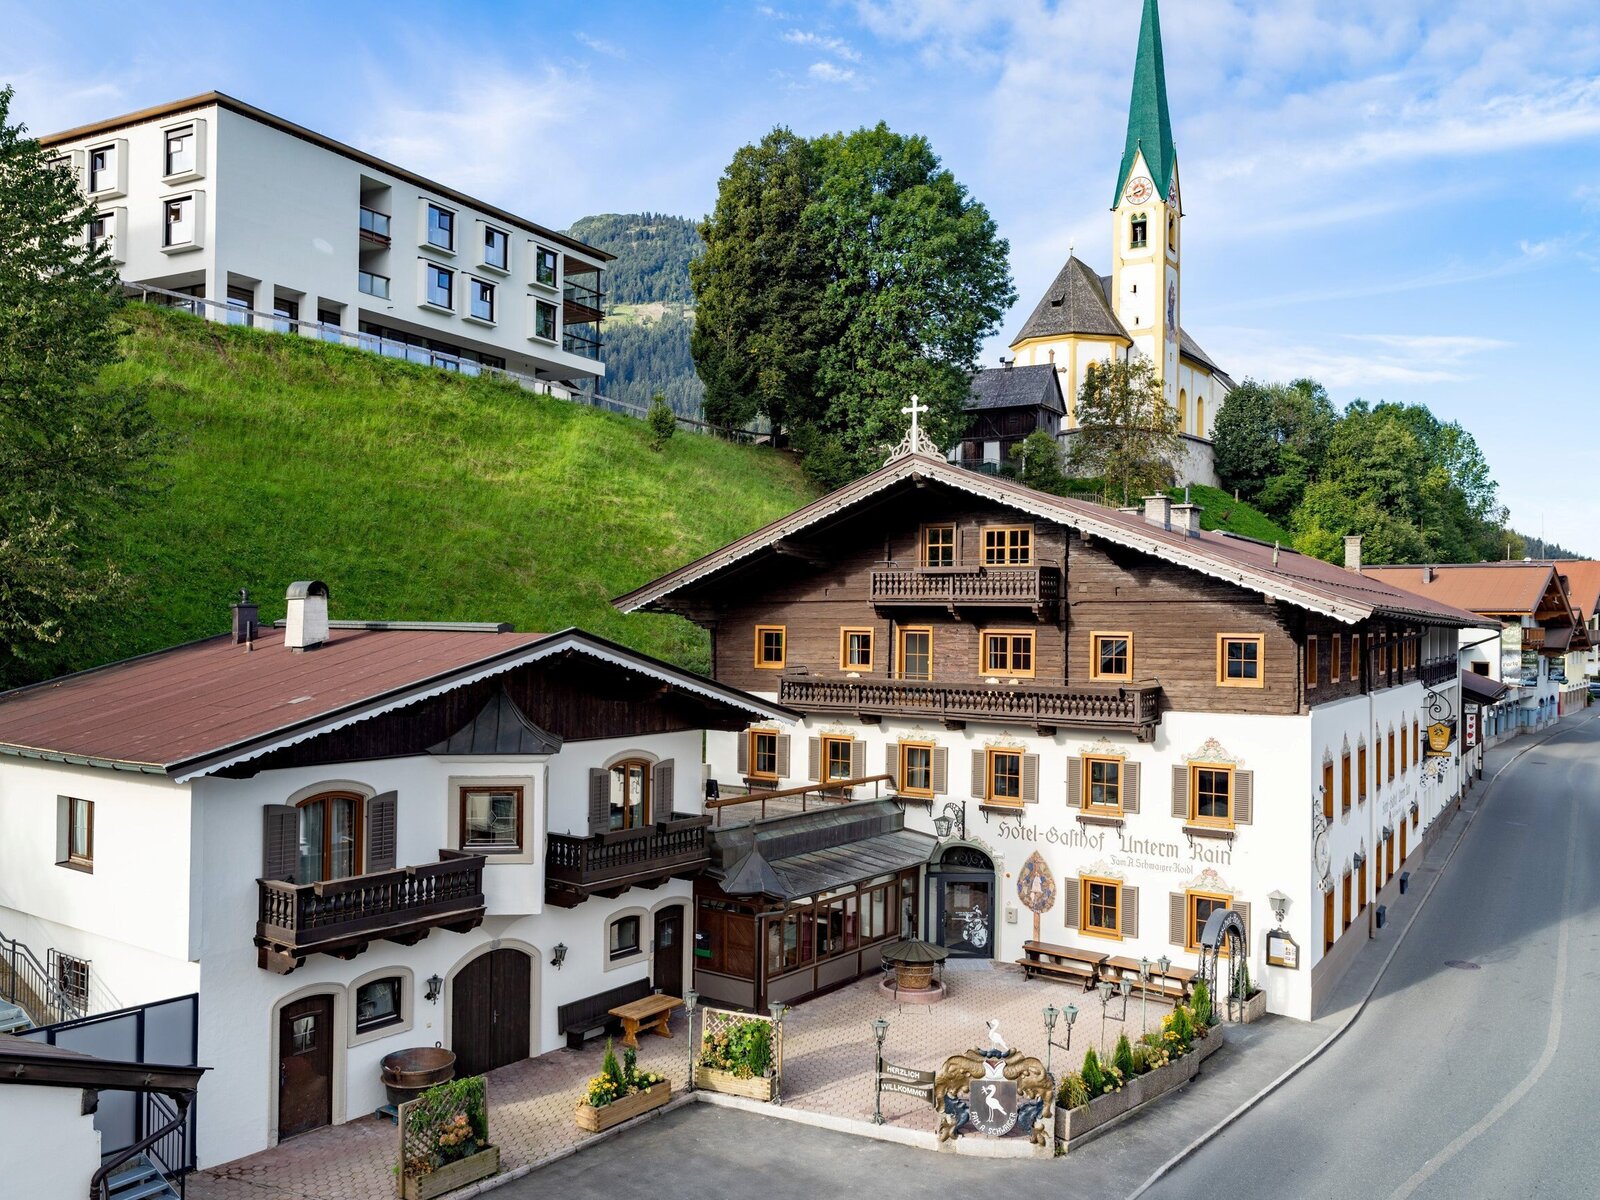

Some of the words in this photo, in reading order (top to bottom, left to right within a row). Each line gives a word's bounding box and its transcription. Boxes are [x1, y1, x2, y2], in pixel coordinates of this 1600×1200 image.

[1120, 834, 1179, 858] Unterm
[1189, 842, 1232, 866] Rain
[886, 1065, 920, 1079] HERZLICH
[880, 1083, 928, 1097] WILLKOMMEN
